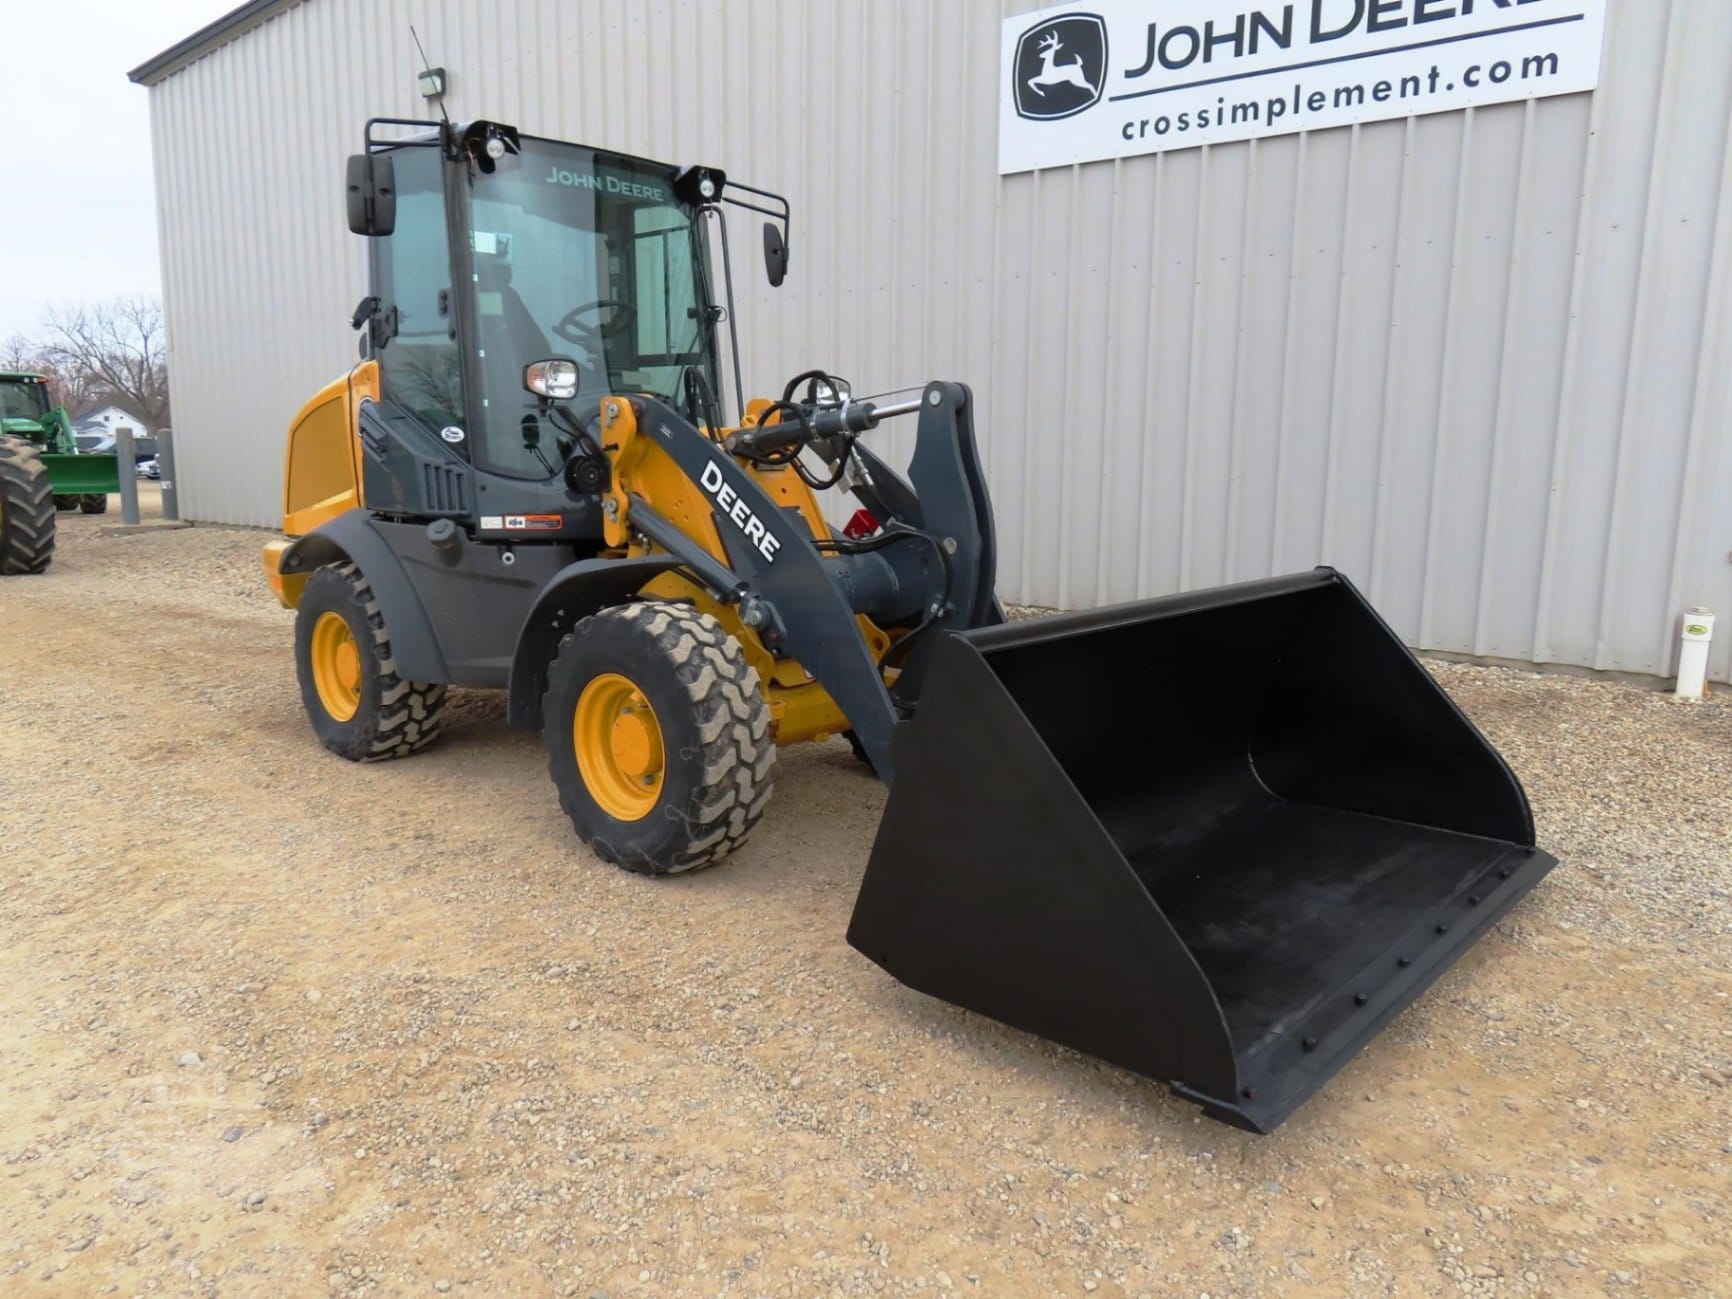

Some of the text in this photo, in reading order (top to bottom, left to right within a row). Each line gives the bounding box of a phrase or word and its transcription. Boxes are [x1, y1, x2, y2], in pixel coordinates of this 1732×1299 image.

[1124, 0, 1541, 79] JOHN DEE
[1122, 52, 1559, 141] crossimplement.com
[546, 166, 664, 202] JOHN DEERE
[700, 459, 781, 563] DEERE
